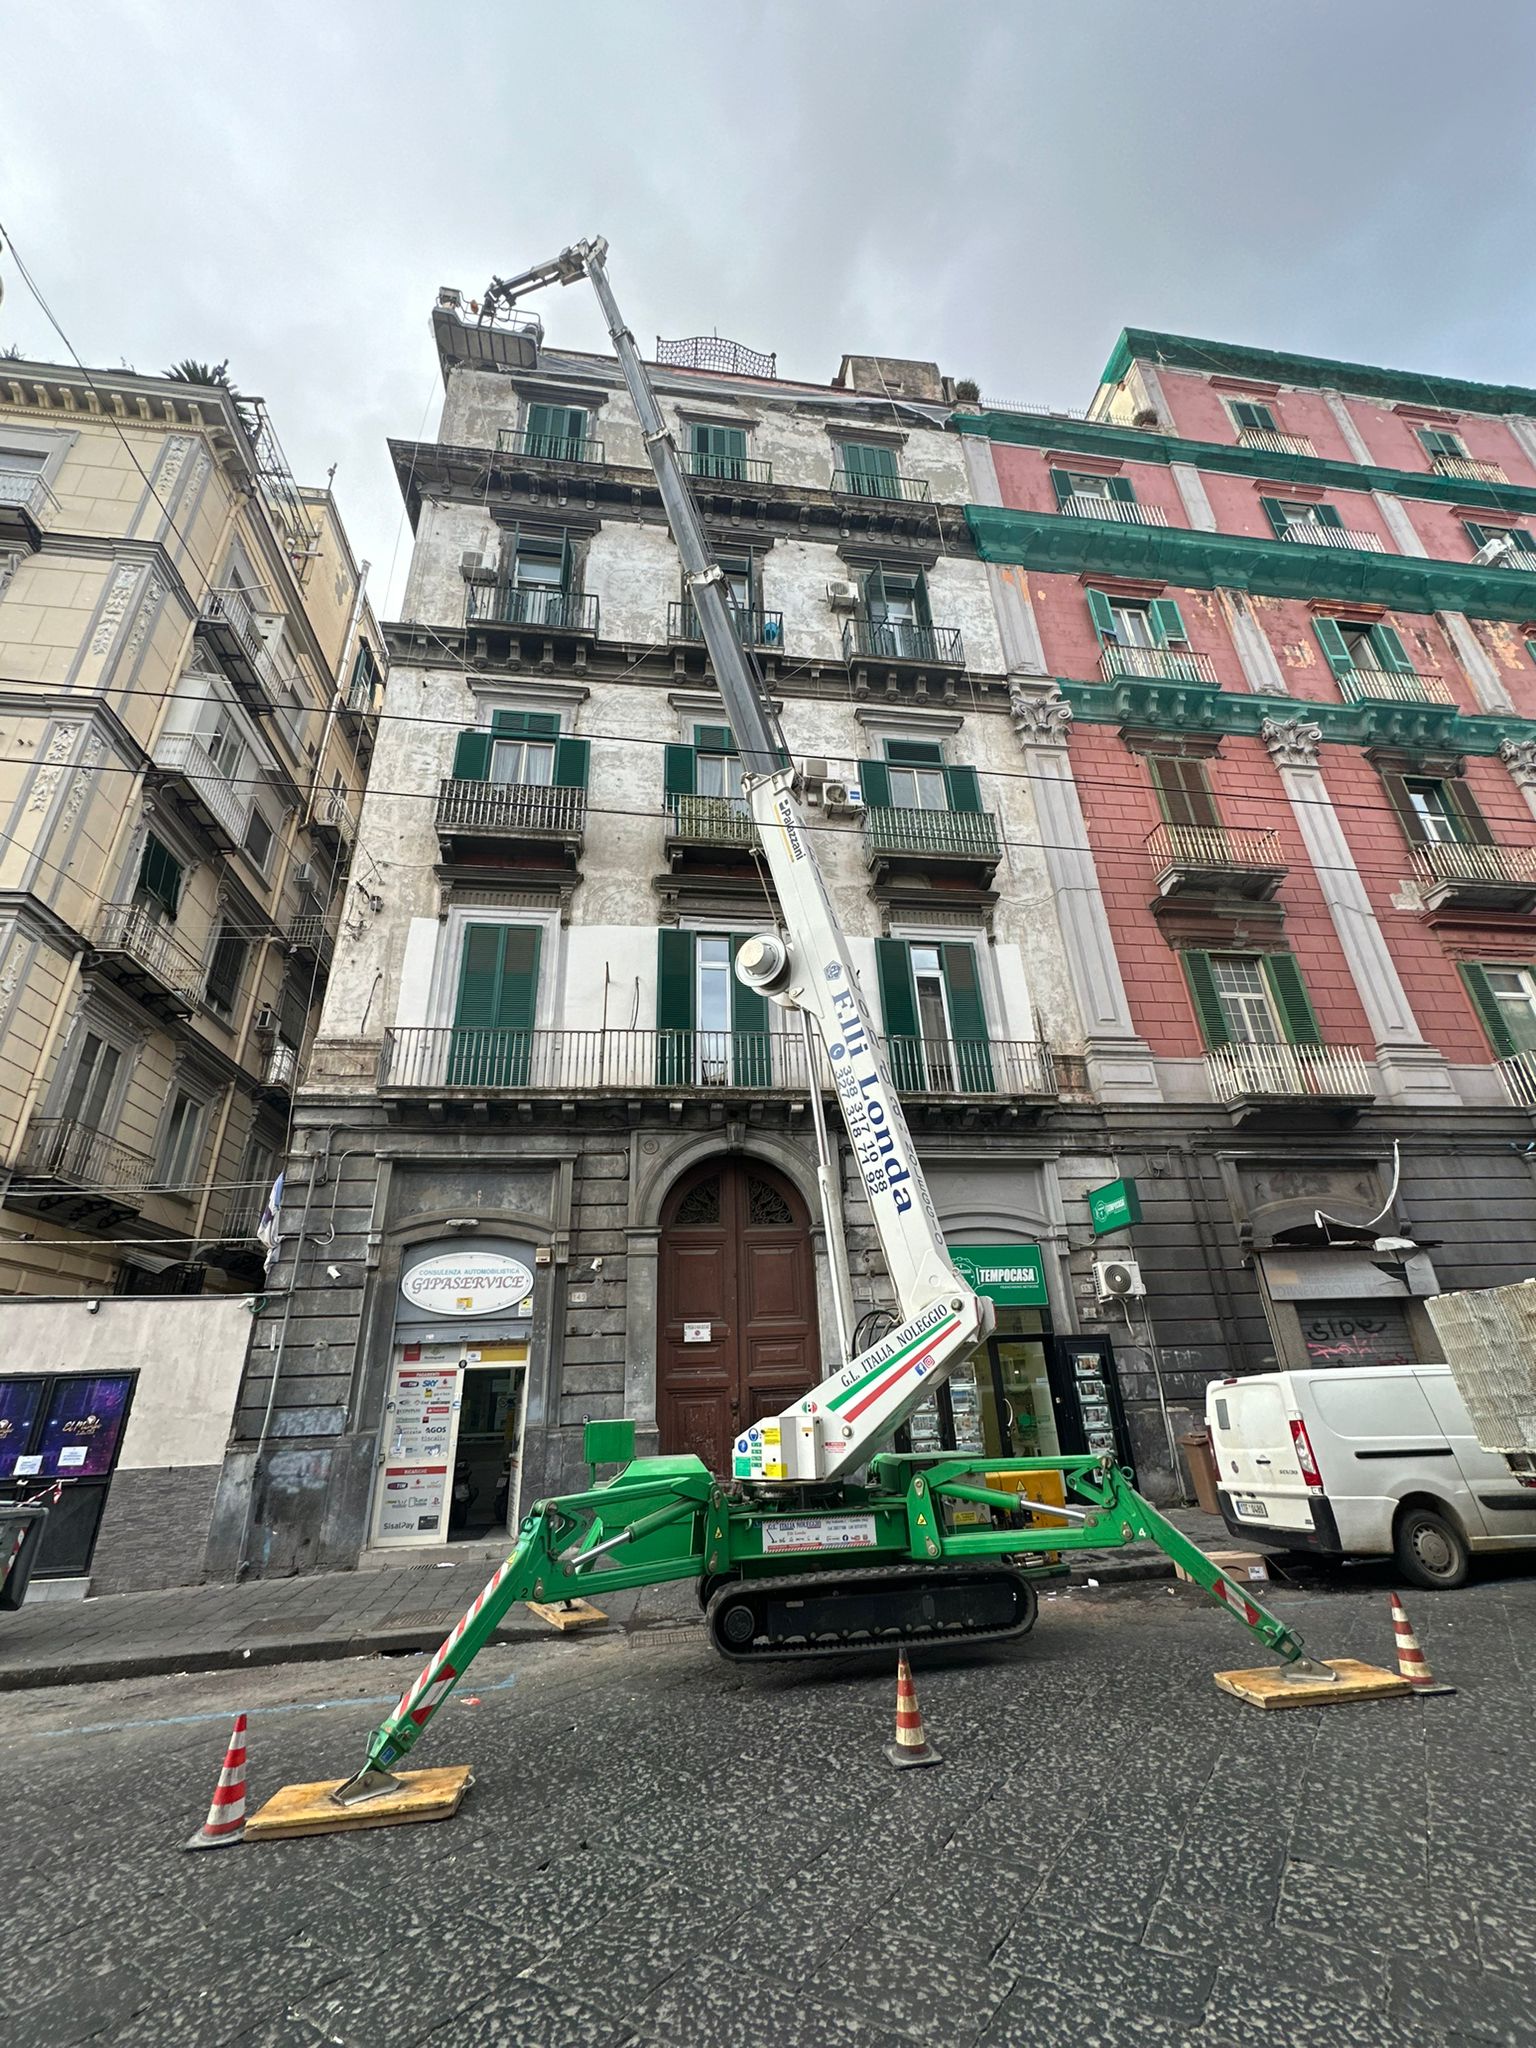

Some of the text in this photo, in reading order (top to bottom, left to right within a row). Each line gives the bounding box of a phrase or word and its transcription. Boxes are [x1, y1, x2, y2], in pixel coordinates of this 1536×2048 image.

[781, 807, 806, 860] Palazzani
[832, 987, 912, 1215] F.lli Londa
[836, 1071, 879, 1196] 327 318 71 92
[845, 1065, 888, 1192] 338 317 10 88
[412, 1275, 525, 1294] GIPASERVICE
[980, 1268, 1035, 1282] TEMPOCASA
[841, 1304, 948, 1387] G.L. ITALIA NOLEGGIO
[383, 1521, 414, 1530] SisalPay
[1138, 1528, 1146, 1537] 4
[521, 1588, 528, 1599] 2
